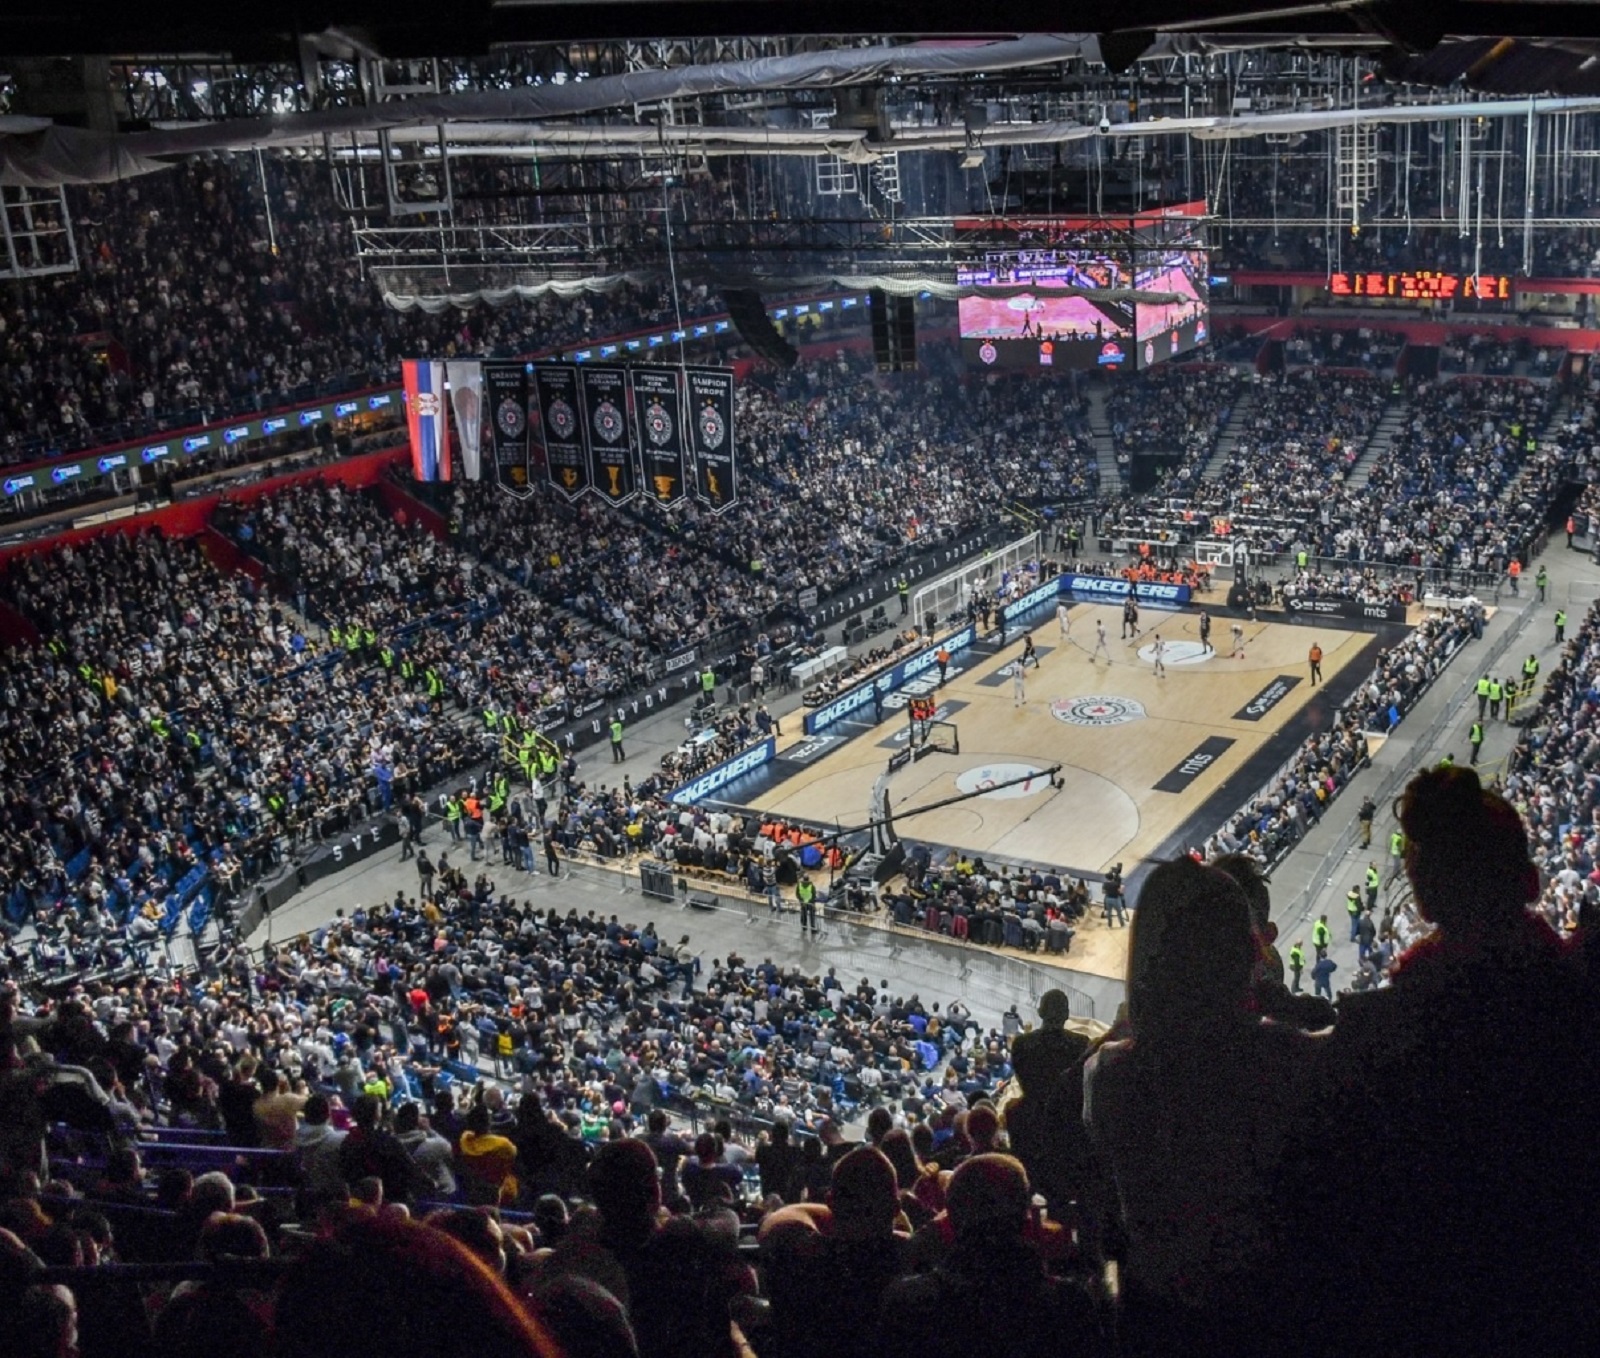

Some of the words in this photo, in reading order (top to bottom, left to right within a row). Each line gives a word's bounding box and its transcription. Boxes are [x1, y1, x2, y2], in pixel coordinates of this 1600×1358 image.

[1003, 579, 1060, 619] SKECHERS
[1071, 577, 1179, 599] SKECHERS
[1364, 608, 1388, 619] mts
[902, 629, 971, 679] SKECERS
[673, 744, 768, 805] SKECHERS
[1179, 753, 1213, 774] mts
